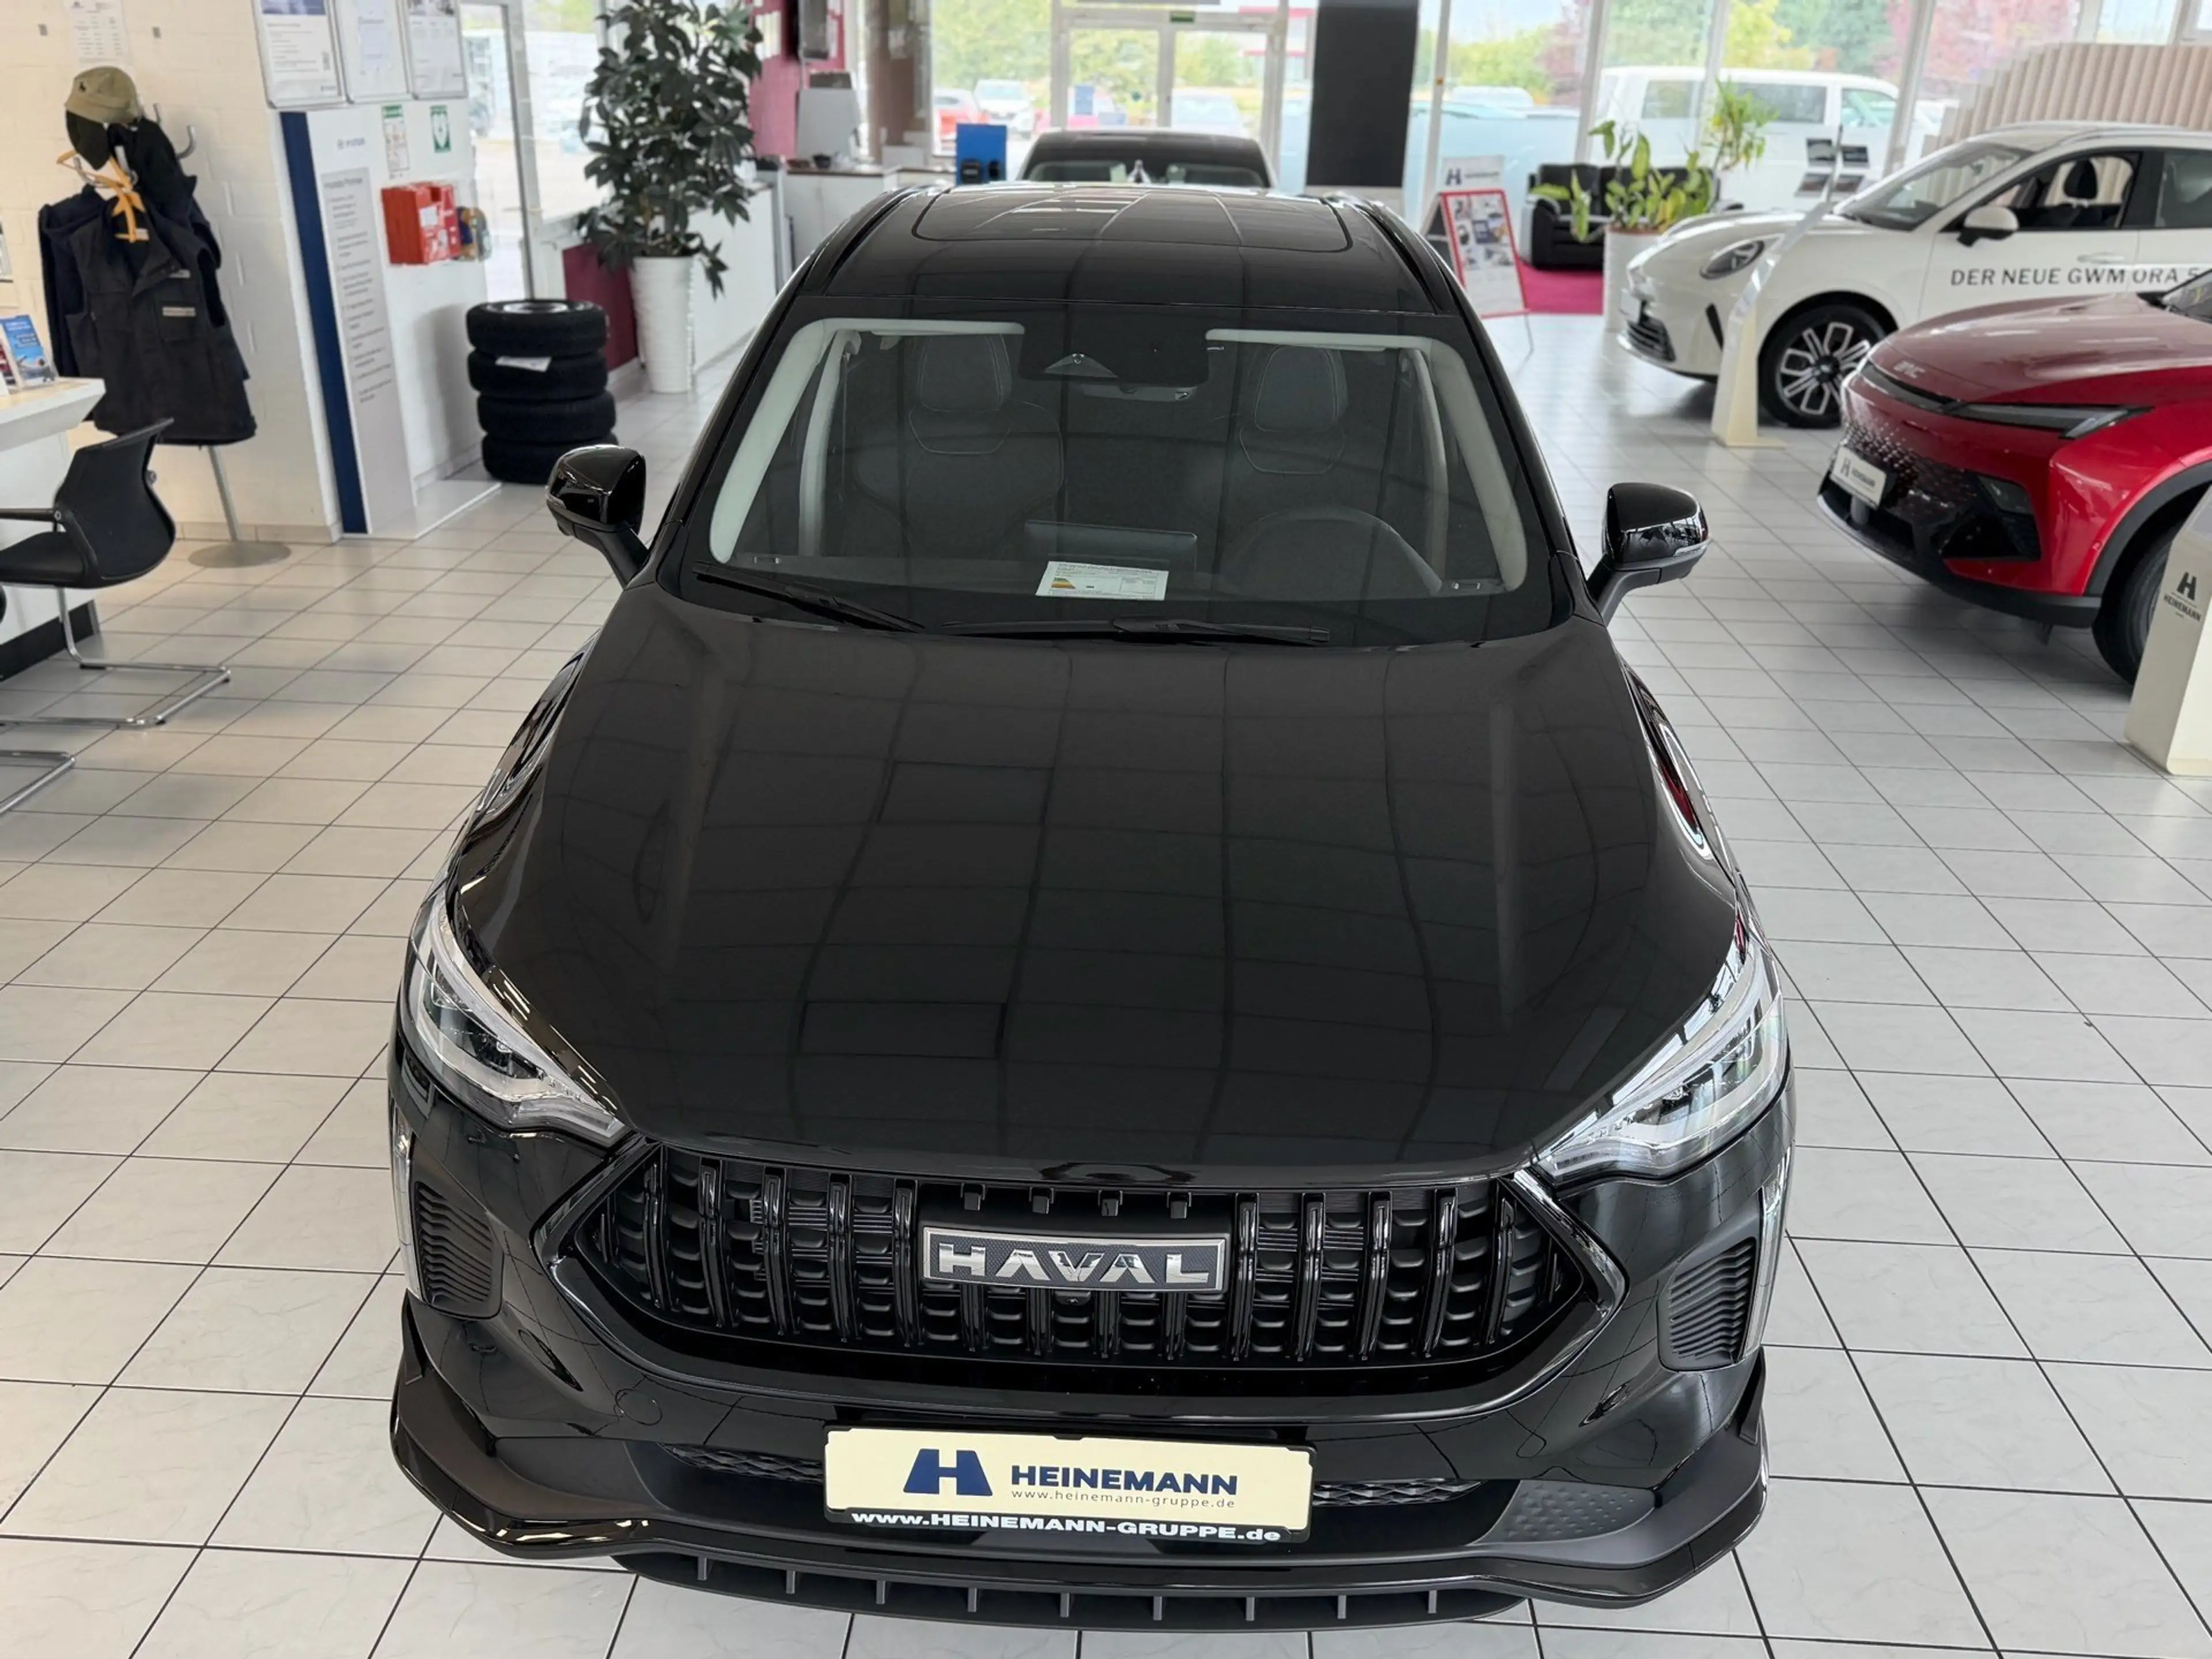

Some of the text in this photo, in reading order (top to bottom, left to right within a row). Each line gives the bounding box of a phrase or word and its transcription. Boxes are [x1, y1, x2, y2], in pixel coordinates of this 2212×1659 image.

[1950, 268, 1995, 286] DER
[2002, 267, 2061, 285] NEUE
[2067, 267, 2126, 285] GWM
[2132, 267, 2178, 284] ORA
[938, 1243, 1209, 1283] HAVAL
[1011, 1465, 1238, 1495] HEINEMANN
[1011, 1489, 1235, 1508] www.heinemann-gruppe.de
[851, 1513, 1281, 1541] www.HEINEMANN-GRUPPE.de
